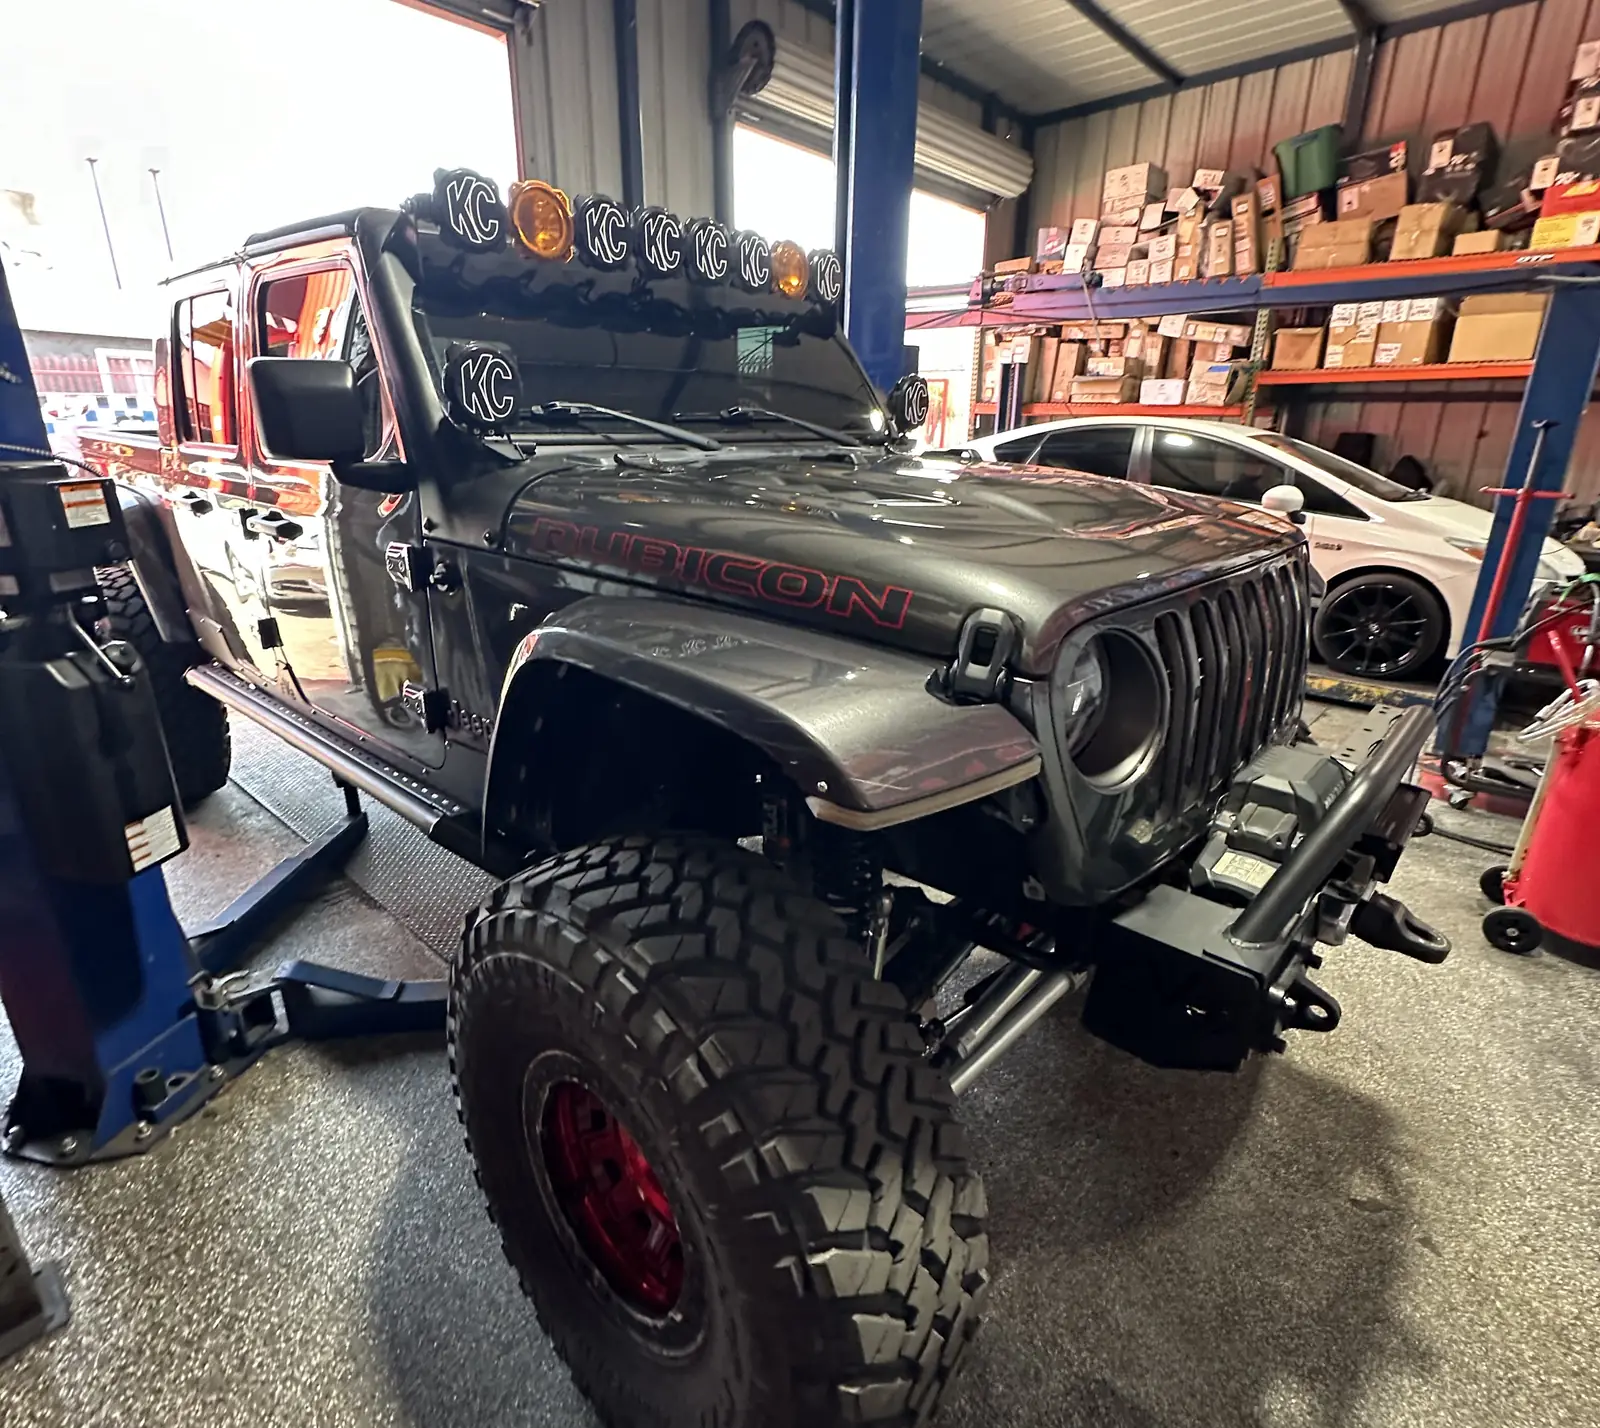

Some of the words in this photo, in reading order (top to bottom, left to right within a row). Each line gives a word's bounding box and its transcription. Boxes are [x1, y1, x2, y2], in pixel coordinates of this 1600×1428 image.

[446, 176, 499, 244] KC
[585, 203, 627, 264] KC
[644, 214, 681, 272] KC
[695, 225, 728, 280] KC
[740, 235, 769, 288] KC
[816, 254, 841, 301] KC
[460, 353, 514, 422] KC
[904, 381, 928, 425] KC
[531, 517, 913, 629] RUBICON
